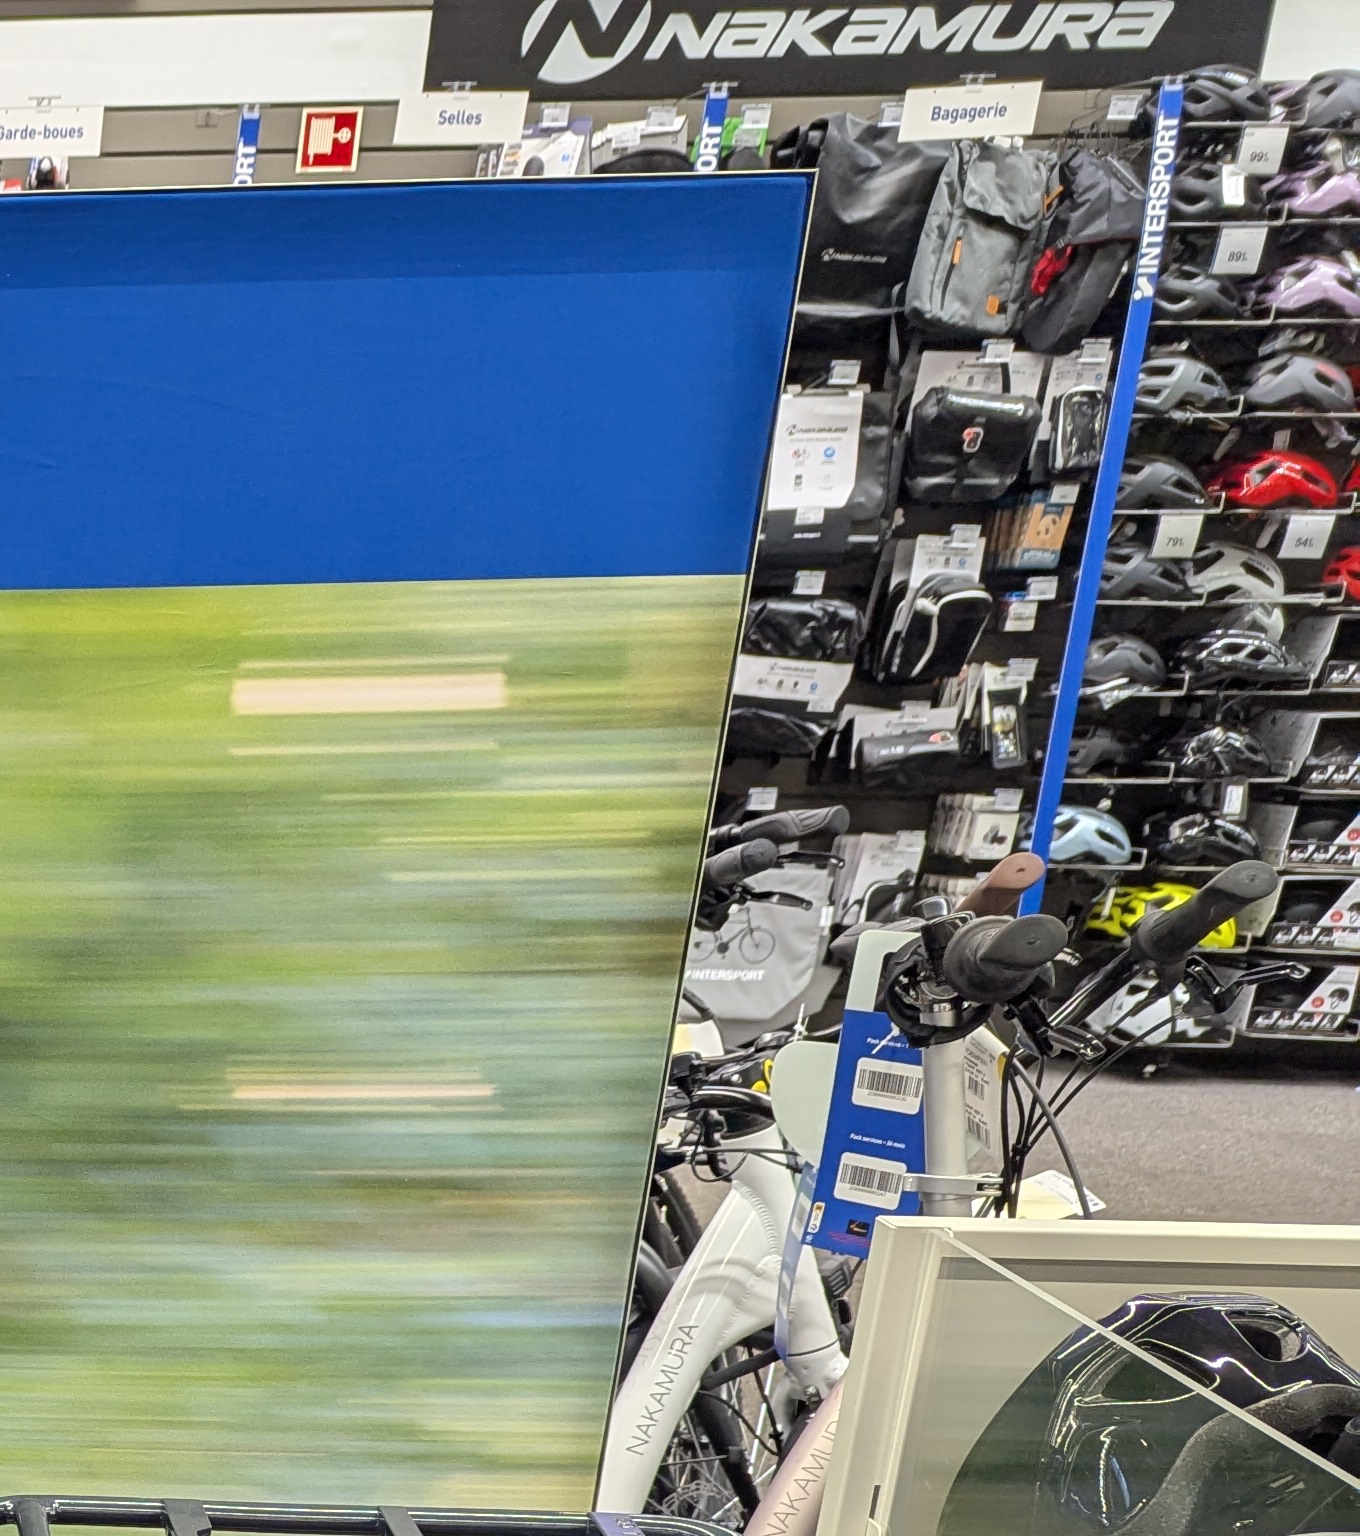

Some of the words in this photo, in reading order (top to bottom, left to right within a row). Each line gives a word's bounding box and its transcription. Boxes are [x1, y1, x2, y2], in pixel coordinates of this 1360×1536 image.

[649, 2, 1175, 59] NAKAMURA
[438, 110, 483, 127] Selles
[931, 101, 1007, 125] Bagagerie
[1138, 117, 1178, 274] INTERSPORT
[691, 969, 765, 982] INTERSPORT
[625, 1323, 699, 1456] NAKAMURA
